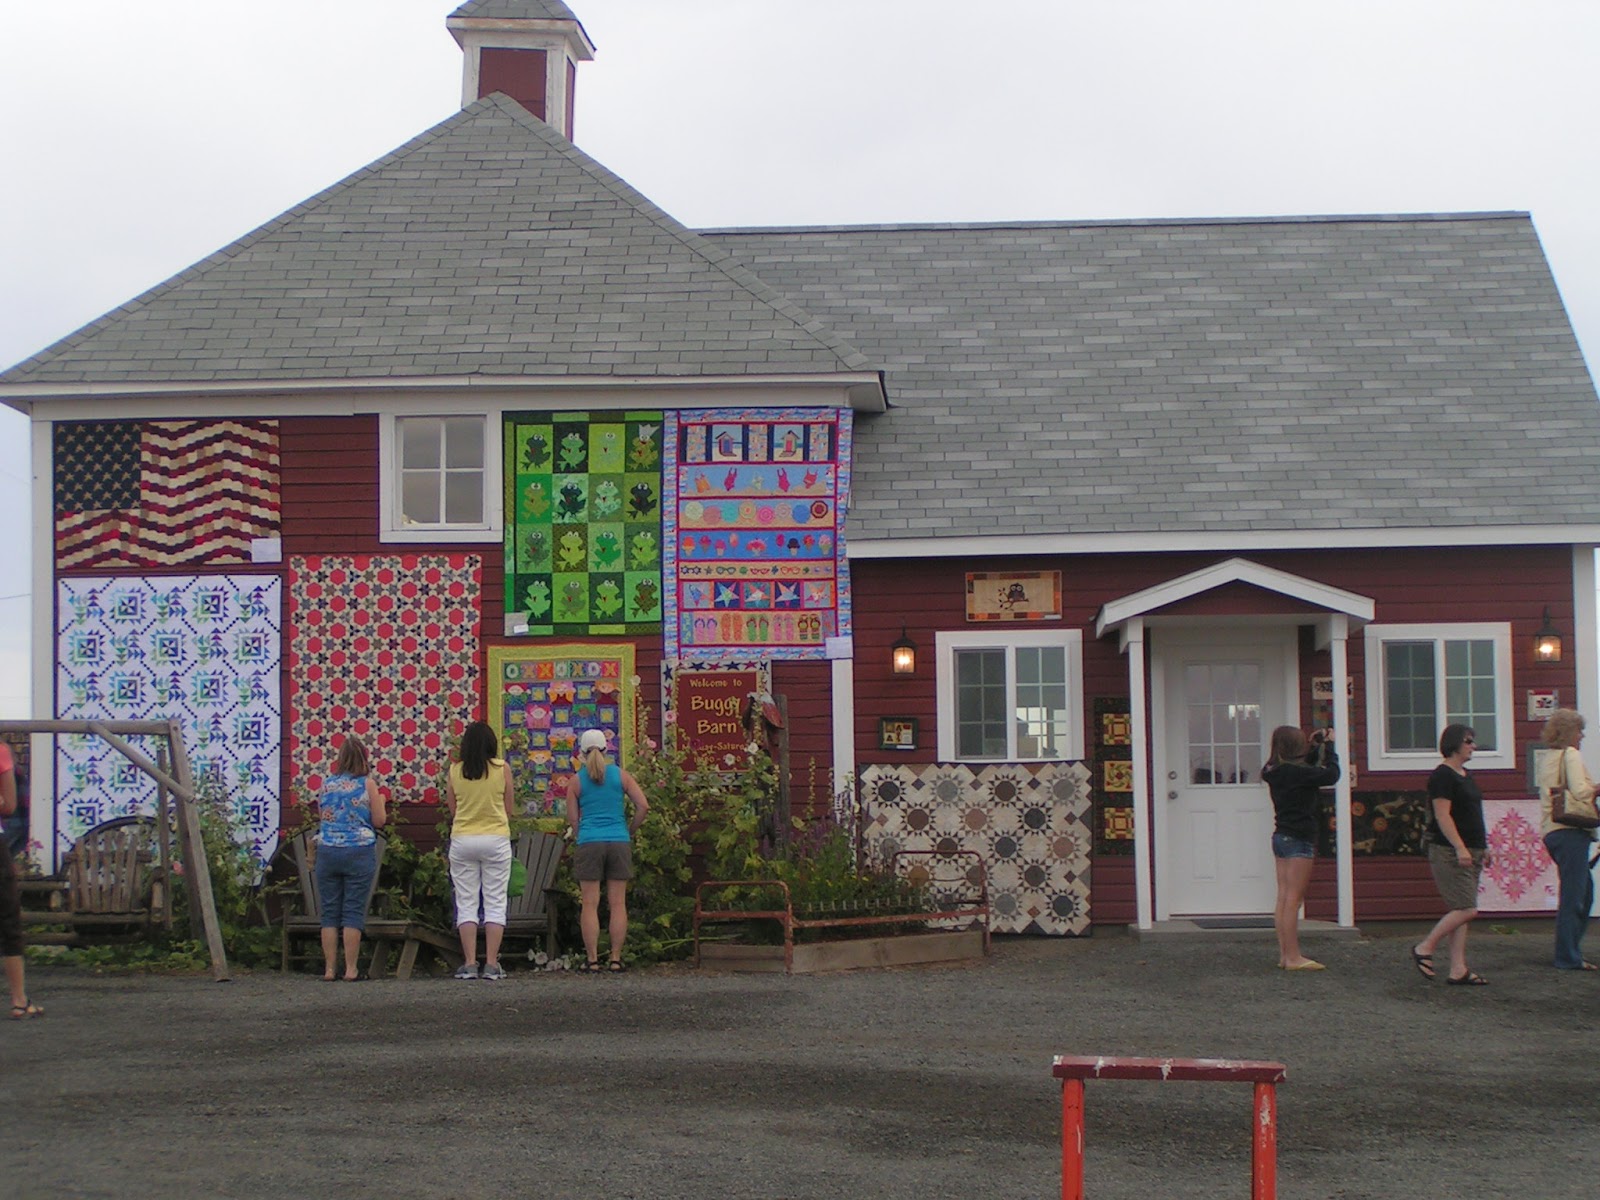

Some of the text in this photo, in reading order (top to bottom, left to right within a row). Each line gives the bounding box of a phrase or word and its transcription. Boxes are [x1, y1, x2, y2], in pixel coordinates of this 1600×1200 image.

[690, 679, 728, 687] Welcome
[691, 695, 741, 716] Buggy
[697, 720, 736, 734] Barn
